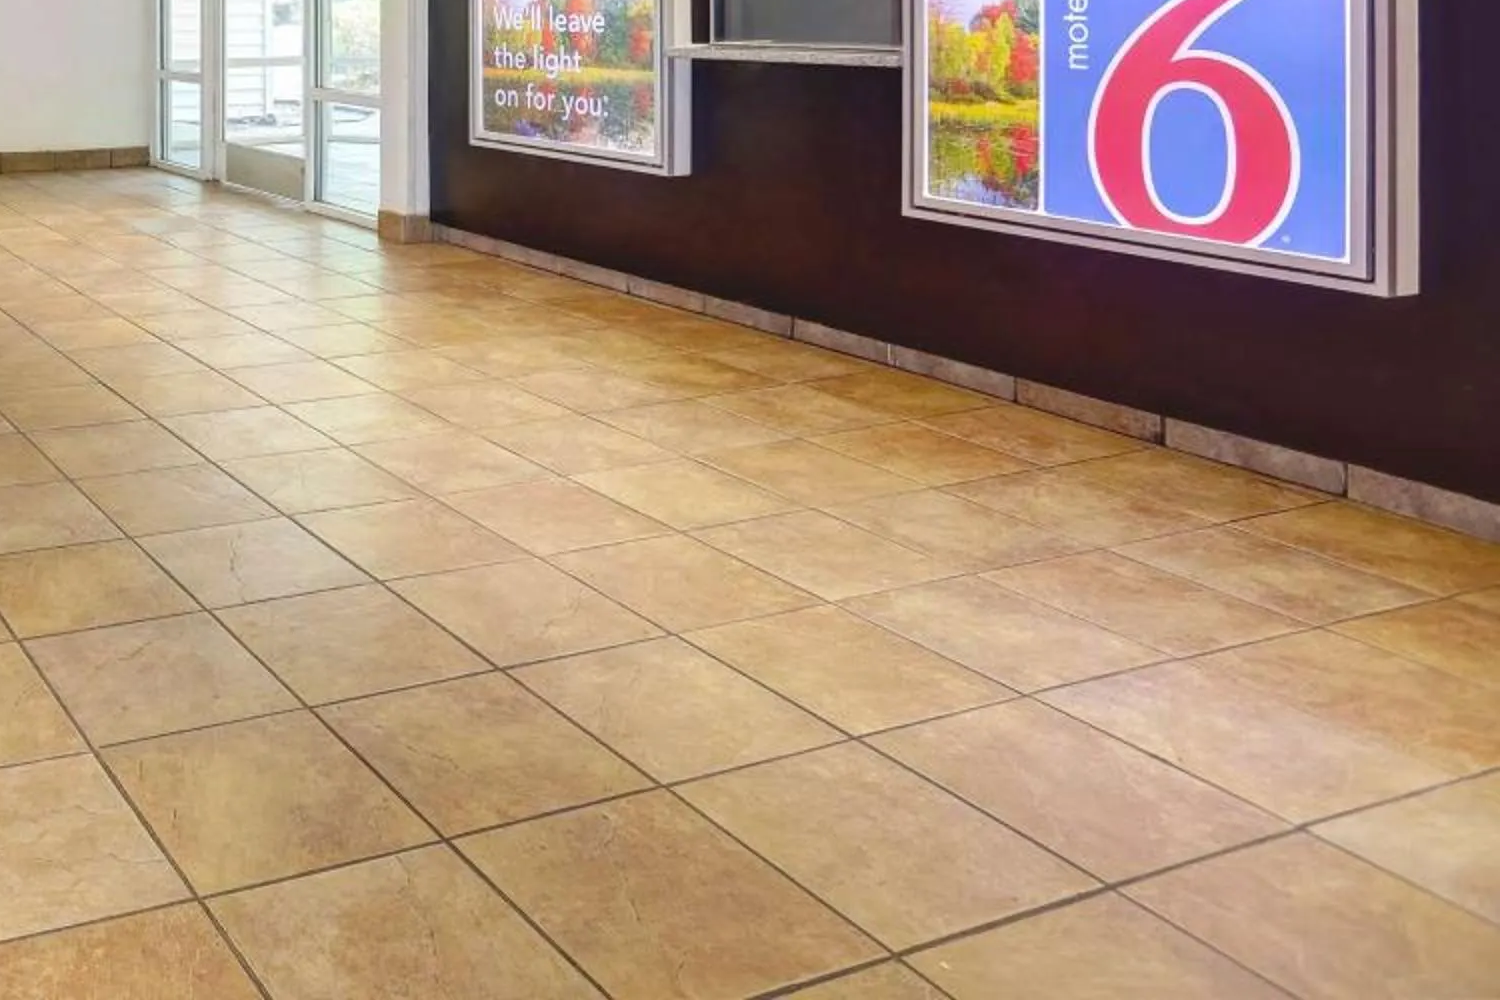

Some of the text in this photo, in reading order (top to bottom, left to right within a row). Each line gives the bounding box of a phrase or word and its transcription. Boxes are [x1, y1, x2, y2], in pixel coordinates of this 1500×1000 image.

[493, 4, 605, 34] We'll leave
[493, 42, 583, 80] the light
[494, 87, 519, 109] on
[524, 82, 556, 112] for
